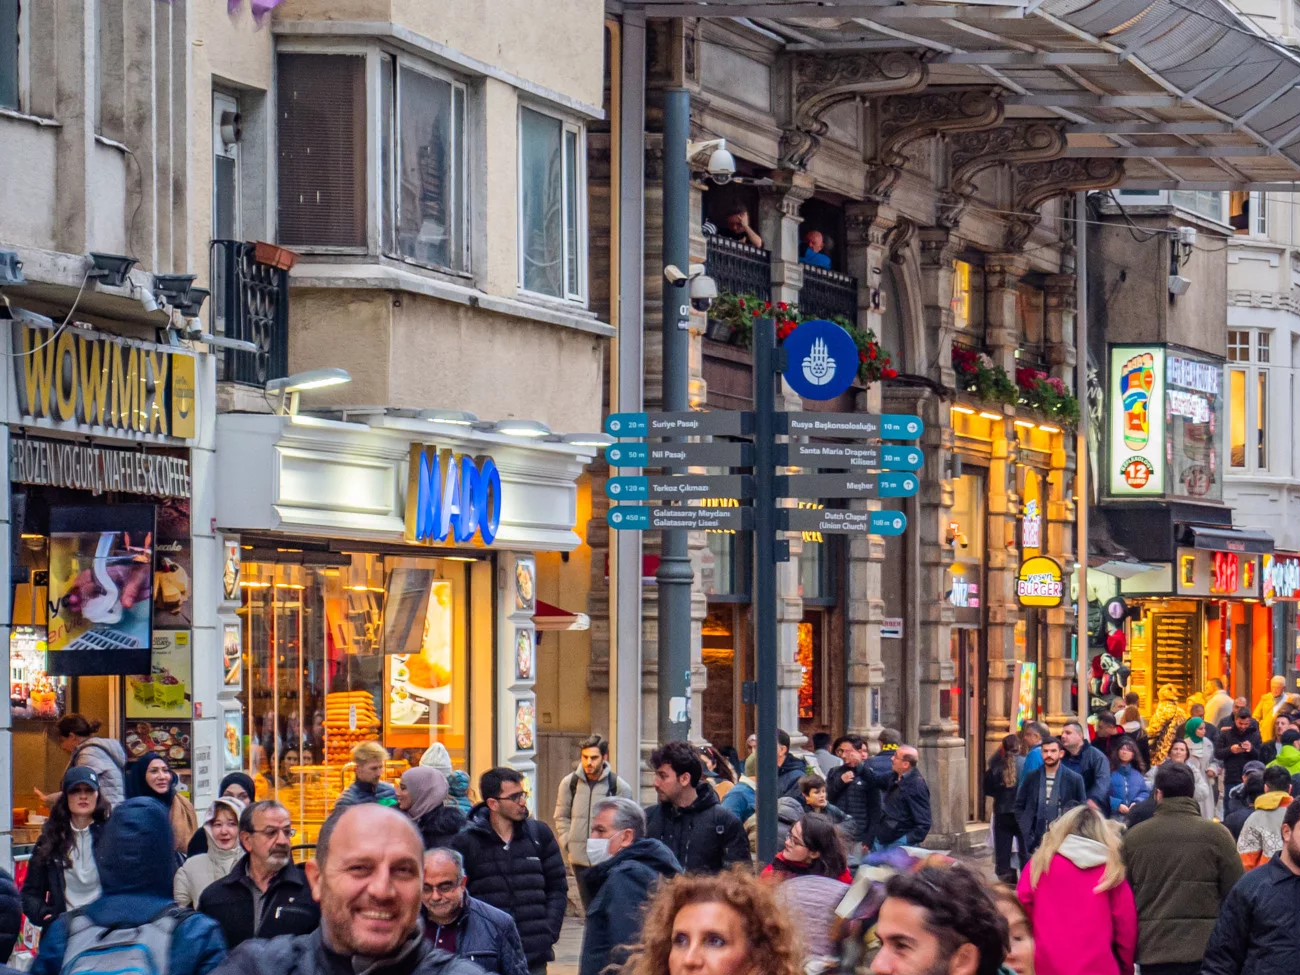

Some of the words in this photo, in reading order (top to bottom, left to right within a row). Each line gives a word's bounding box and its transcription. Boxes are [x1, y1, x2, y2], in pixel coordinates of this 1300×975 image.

[22, 323, 168, 436] WOWMIX
[652, 420, 676, 430] Suriye
[791, 420, 813, 430] Rusya
[814, 421, 877, 432] Başkonsolosluğu
[799, 446, 821, 455] Santa
[821, 447, 843, 456] Maria
[844, 448, 877, 458] Draperis
[12, 438, 55, 485] FROZEN
[850, 458, 877, 466] Kilisesi
[1126, 464, 1147, 478] 12
[846, 482, 874, 491] Meşher
[415, 450, 502, 545] MADO
[653, 509, 696, 518] Galatasaray
[697, 509, 730, 518] Meydanı
[824, 512, 844, 520] Dutch
[845, 512, 867, 521] Chapel
[653, 518, 696, 527] Galatasaray
[697, 519, 718, 527] Lisesi
[819, 521, 841, 530] (Union
[842, 522, 867, 531] Church)
[1018, 581, 1062, 596] BURGER
